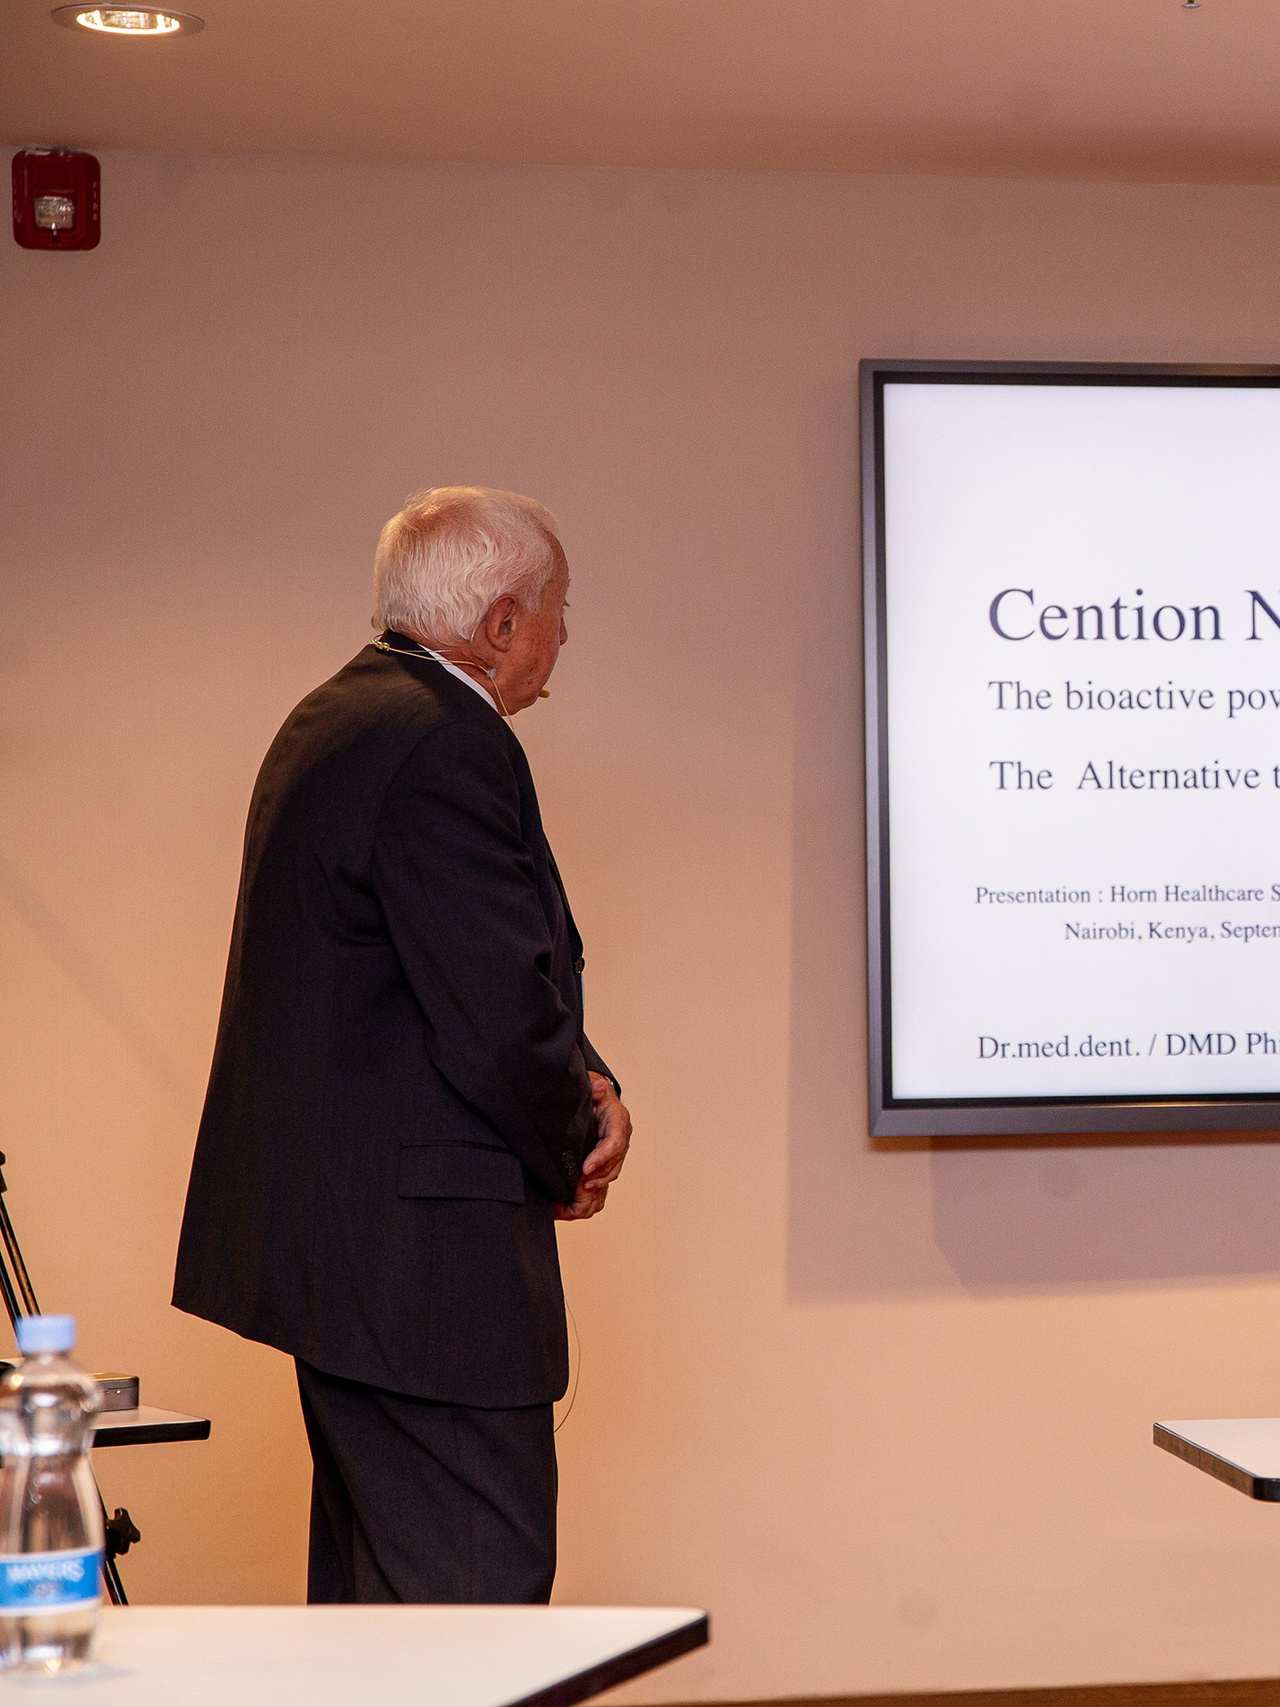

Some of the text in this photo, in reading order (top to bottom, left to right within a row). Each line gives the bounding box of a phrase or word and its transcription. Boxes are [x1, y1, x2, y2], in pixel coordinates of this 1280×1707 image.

[988, 588, 1224, 642] Cention
[988, 680, 1052, 711] The
[1064, 680, 1215, 711] bioactive
[989, 760, 1054, 791] The
[1076, 759, 1261, 790] Alternative
[976, 886, 1091, 904] Presentation
[1110, 885, 1157, 903] Horn
[1164, 884, 1264, 903] Healthcare
[1064, 922, 1142, 940] Nairobi,
[1148, 921, 1215, 944] Kenya,
[977, 1034, 1140, 1059] Dr.med.dent.
[1165, 1032, 1237, 1056] DMD
